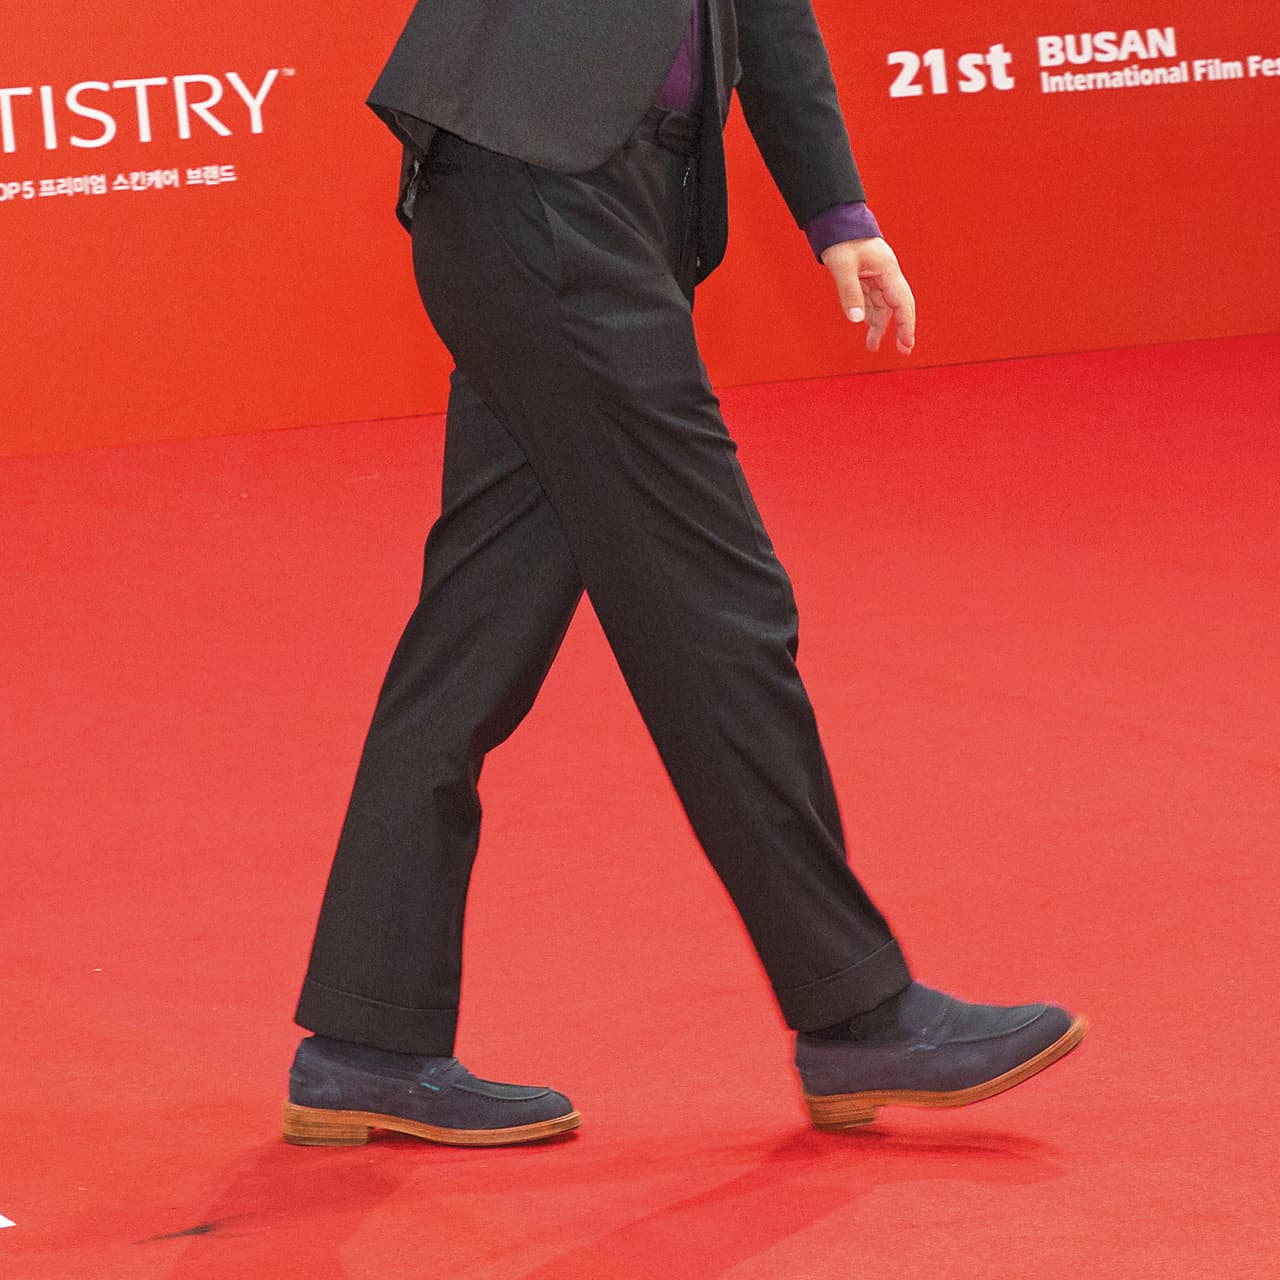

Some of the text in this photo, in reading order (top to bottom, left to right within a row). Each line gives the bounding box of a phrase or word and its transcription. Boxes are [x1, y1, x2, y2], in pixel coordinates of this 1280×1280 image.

[886, 27, 1177, 98] 21st BUSAN
[1040, 60, 1189, 94] International
[1193, 57, 1244, 81] Film
[185, 164, 239, 185] 브랜드
